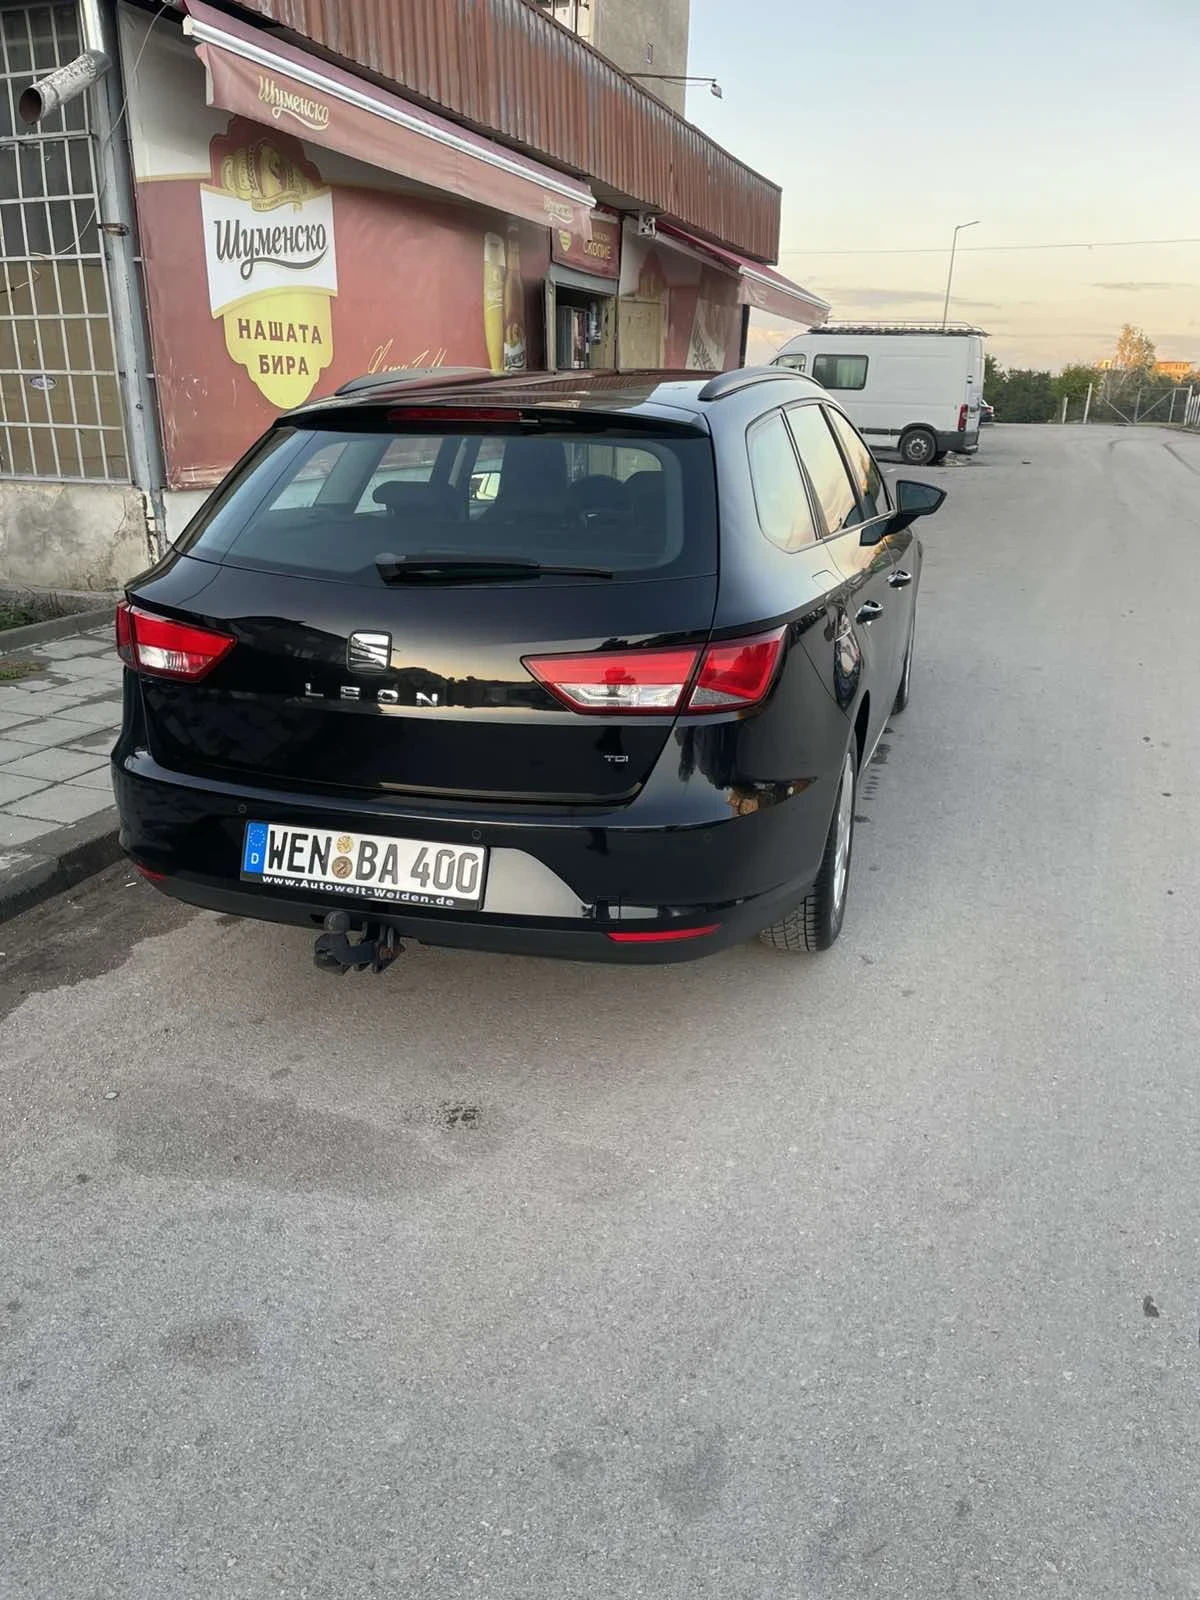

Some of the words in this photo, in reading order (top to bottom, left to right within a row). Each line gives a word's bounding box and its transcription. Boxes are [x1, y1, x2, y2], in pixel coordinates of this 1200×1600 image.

[258, 75, 330, 130] Шуменско
[213, 219, 329, 280] Шуменско
[237, 317, 322, 344] НАШАТА
[259, 354, 309, 376] БИРА
[304, 682, 439, 706] LEON
[603, 755, 629, 763] TDI
[250, 852, 260, 865] D
[267, 829, 333, 877] WEN
[355, 839, 399, 885] BA
[410, 847, 480, 894] 400
[262, 875, 455, 907] www.Autowelt-Weiden.de
